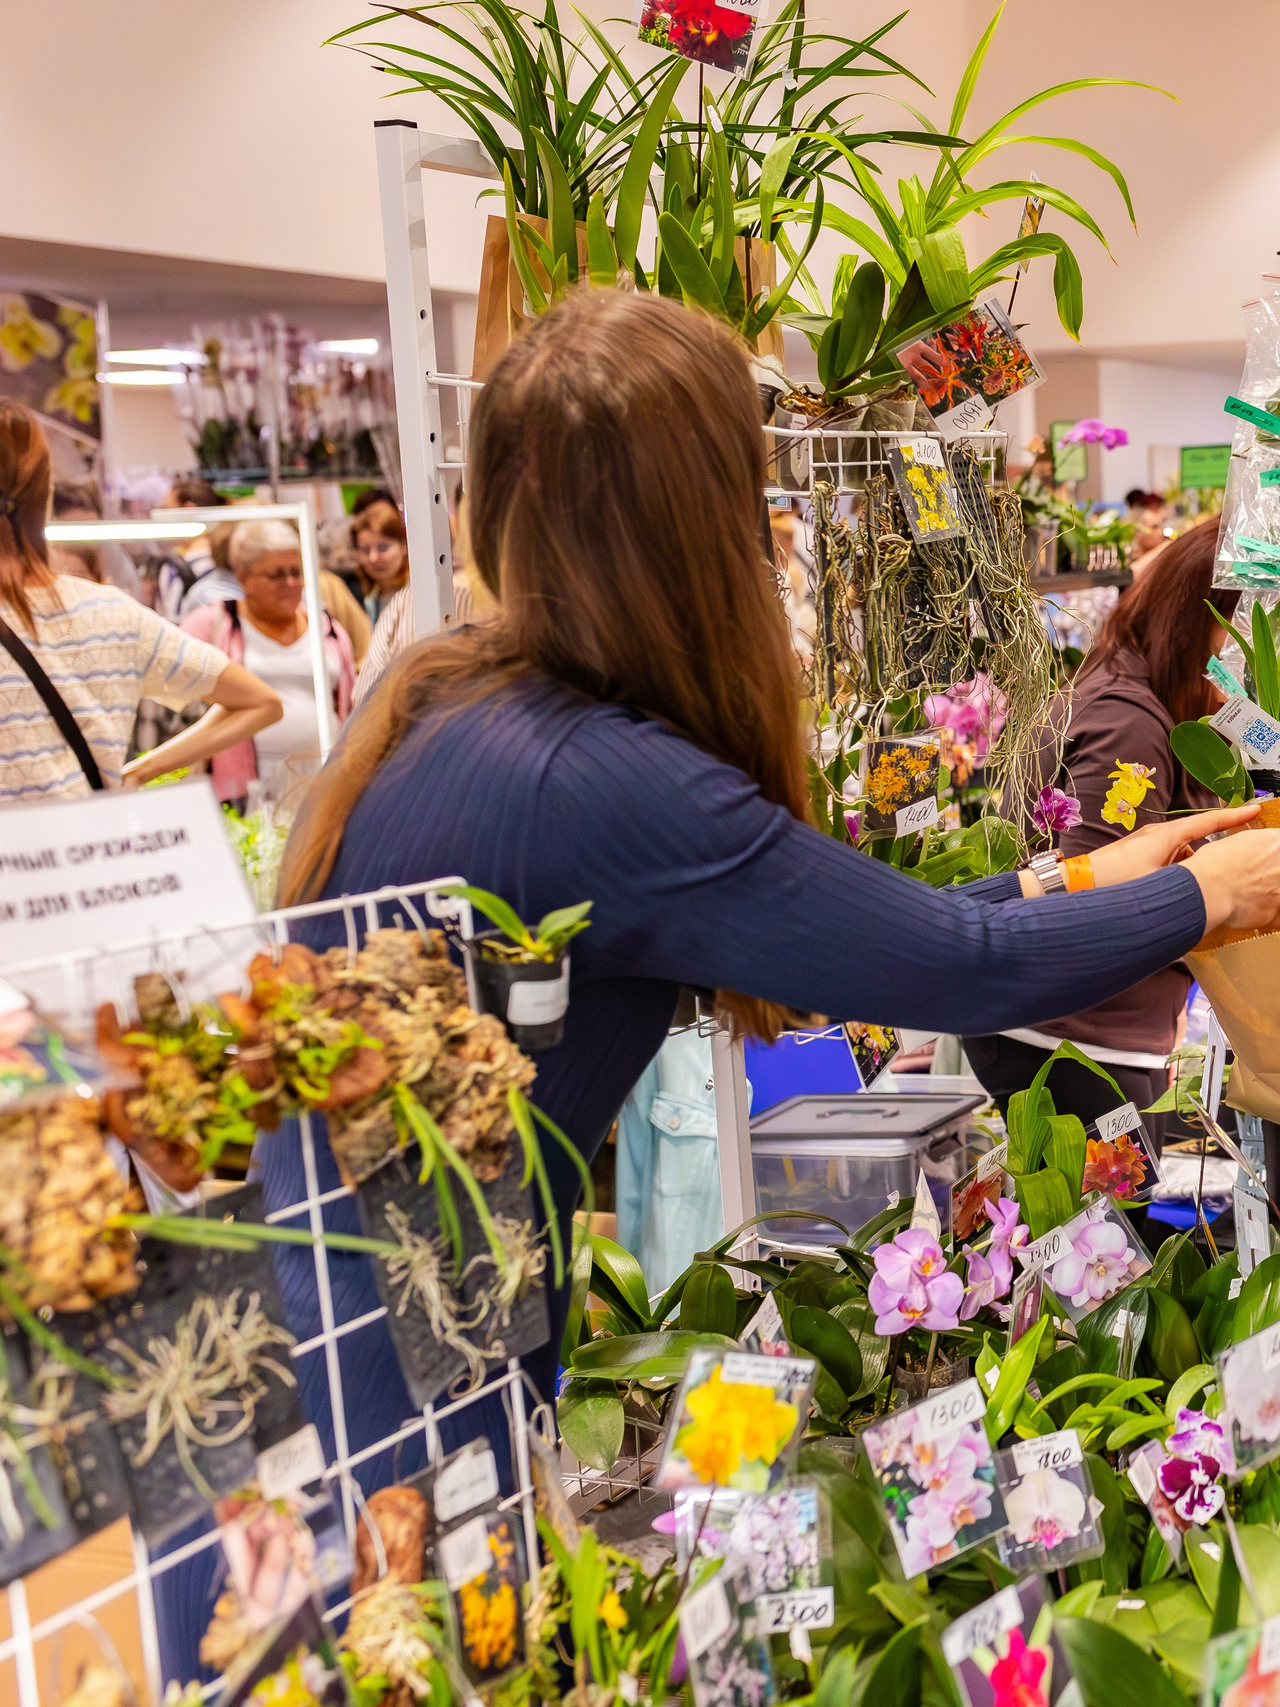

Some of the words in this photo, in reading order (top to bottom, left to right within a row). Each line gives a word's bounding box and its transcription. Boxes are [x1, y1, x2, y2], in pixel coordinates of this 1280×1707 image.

[916, 442, 937, 459] 2100
[904, 801, 934, 827] 1400
[65, 828, 188, 864] ОРХИДЕИ
[78, 874, 182, 909] БЛОКОВ
[1105, 1111, 1134, 1138] 1300
[930, 1391, 977, 1428] 1300
[1038, 1447, 1071, 1470] 1800
